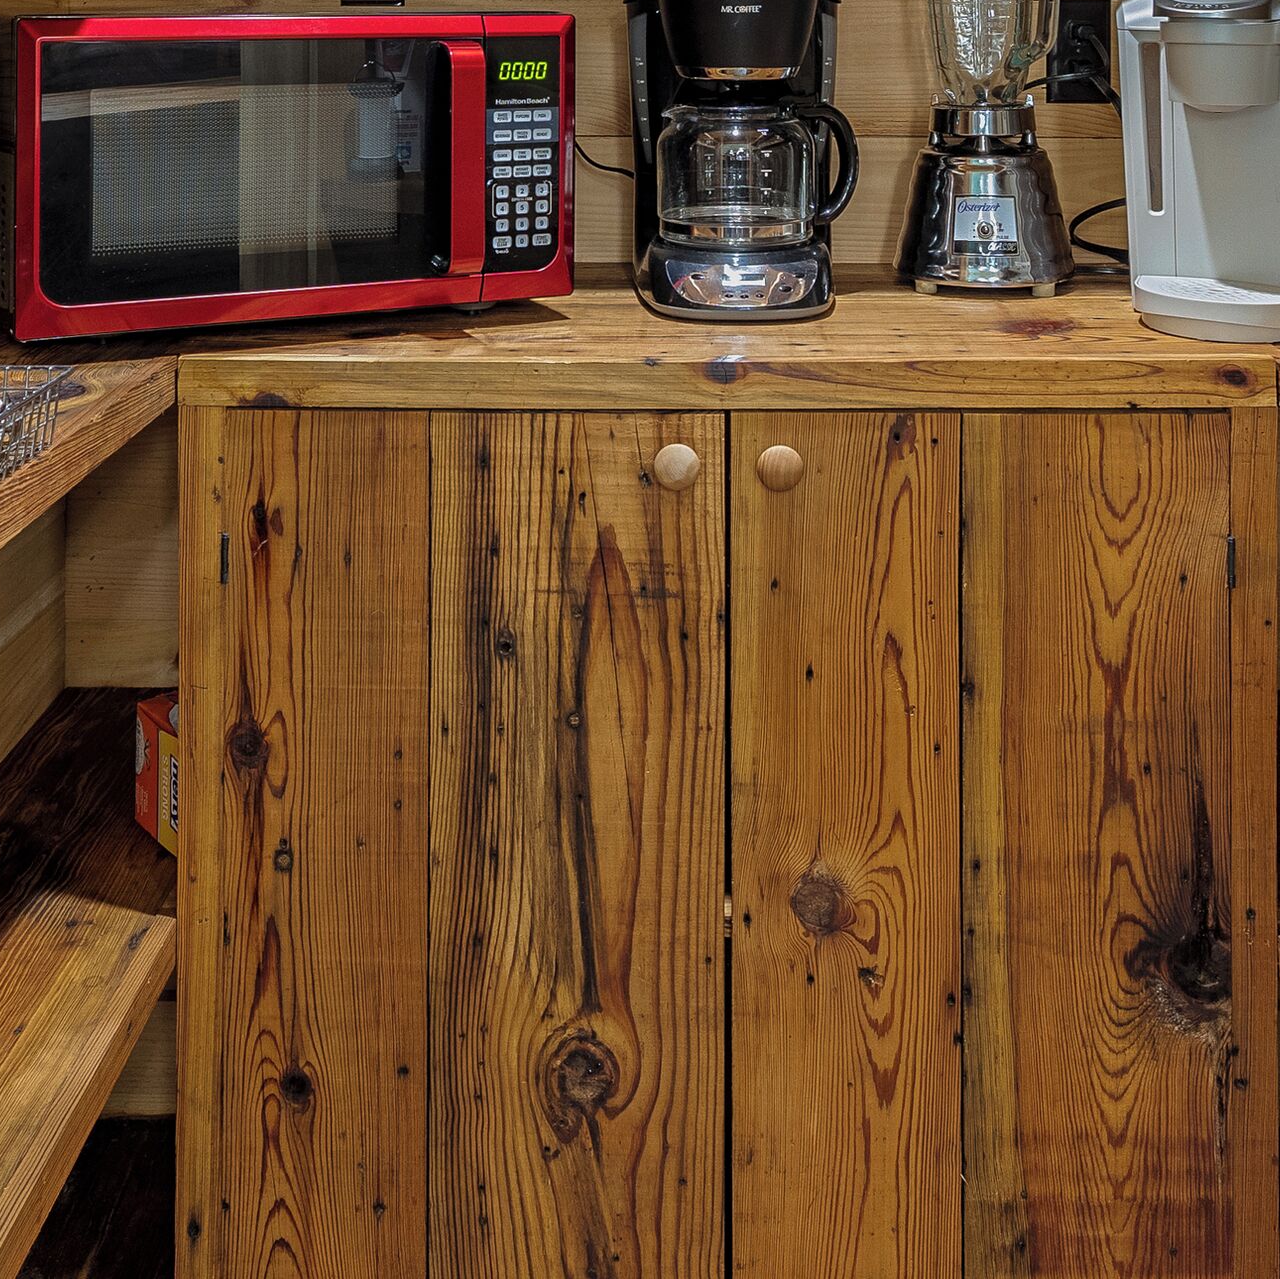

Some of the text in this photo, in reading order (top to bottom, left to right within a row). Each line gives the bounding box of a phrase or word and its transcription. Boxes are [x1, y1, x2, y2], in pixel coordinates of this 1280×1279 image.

[498, 61, 548, 81] 0000
[495, 98, 527, 106] Hamilton
[957, 199, 1000, 213] Osterizer
[161, 755, 169, 821] STRONG
